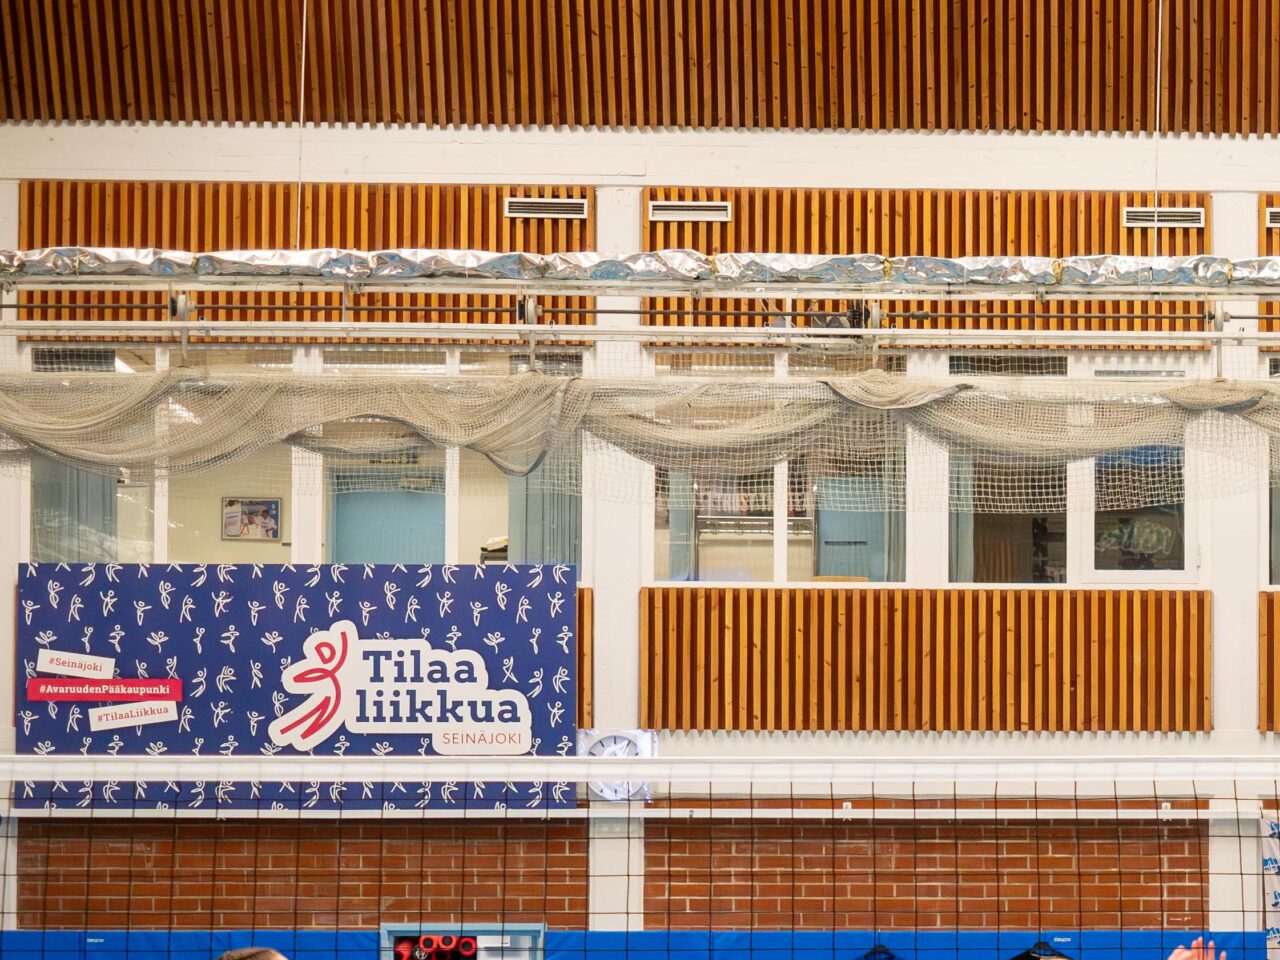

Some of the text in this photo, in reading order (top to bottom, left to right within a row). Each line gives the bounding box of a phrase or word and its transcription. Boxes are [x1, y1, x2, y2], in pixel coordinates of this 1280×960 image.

[48, 657, 103, 672] #Seinäjoki
[362, 649, 478, 683] Tilaa
[39, 684, 170, 696] #AvaruudenPääkaupunki
[355, 689, 521, 723] liikkua
[97, 706, 169, 722] #TilaaLiikkua
[442, 730, 522, 744] SEINÄJOKI
